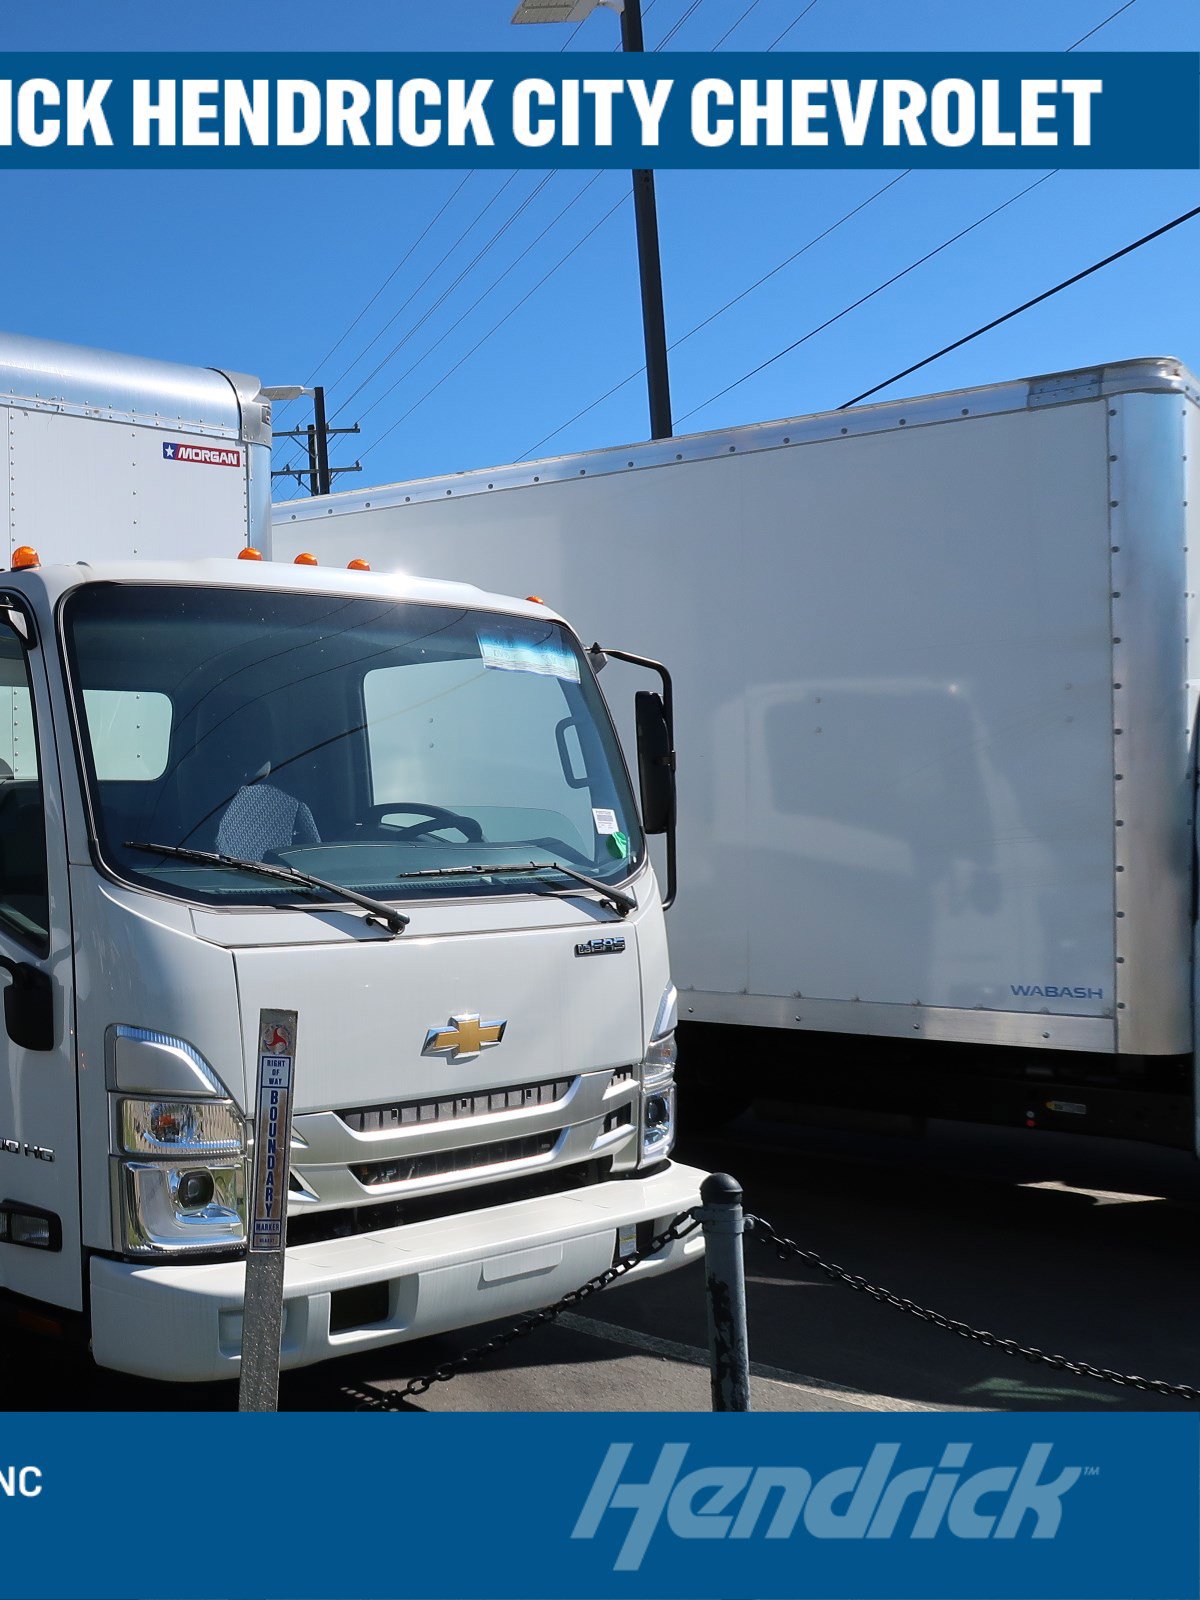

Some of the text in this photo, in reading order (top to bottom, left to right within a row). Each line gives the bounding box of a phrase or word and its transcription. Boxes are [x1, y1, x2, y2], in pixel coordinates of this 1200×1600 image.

[178, 447, 238, 465] MORGAN
[1010, 985, 1103, 1000] WABASH
[24, 1143, 56, 1162] HG
[265, 1090, 279, 1218] BOUNDARY
[256, 1223, 280, 1232] MARKER
